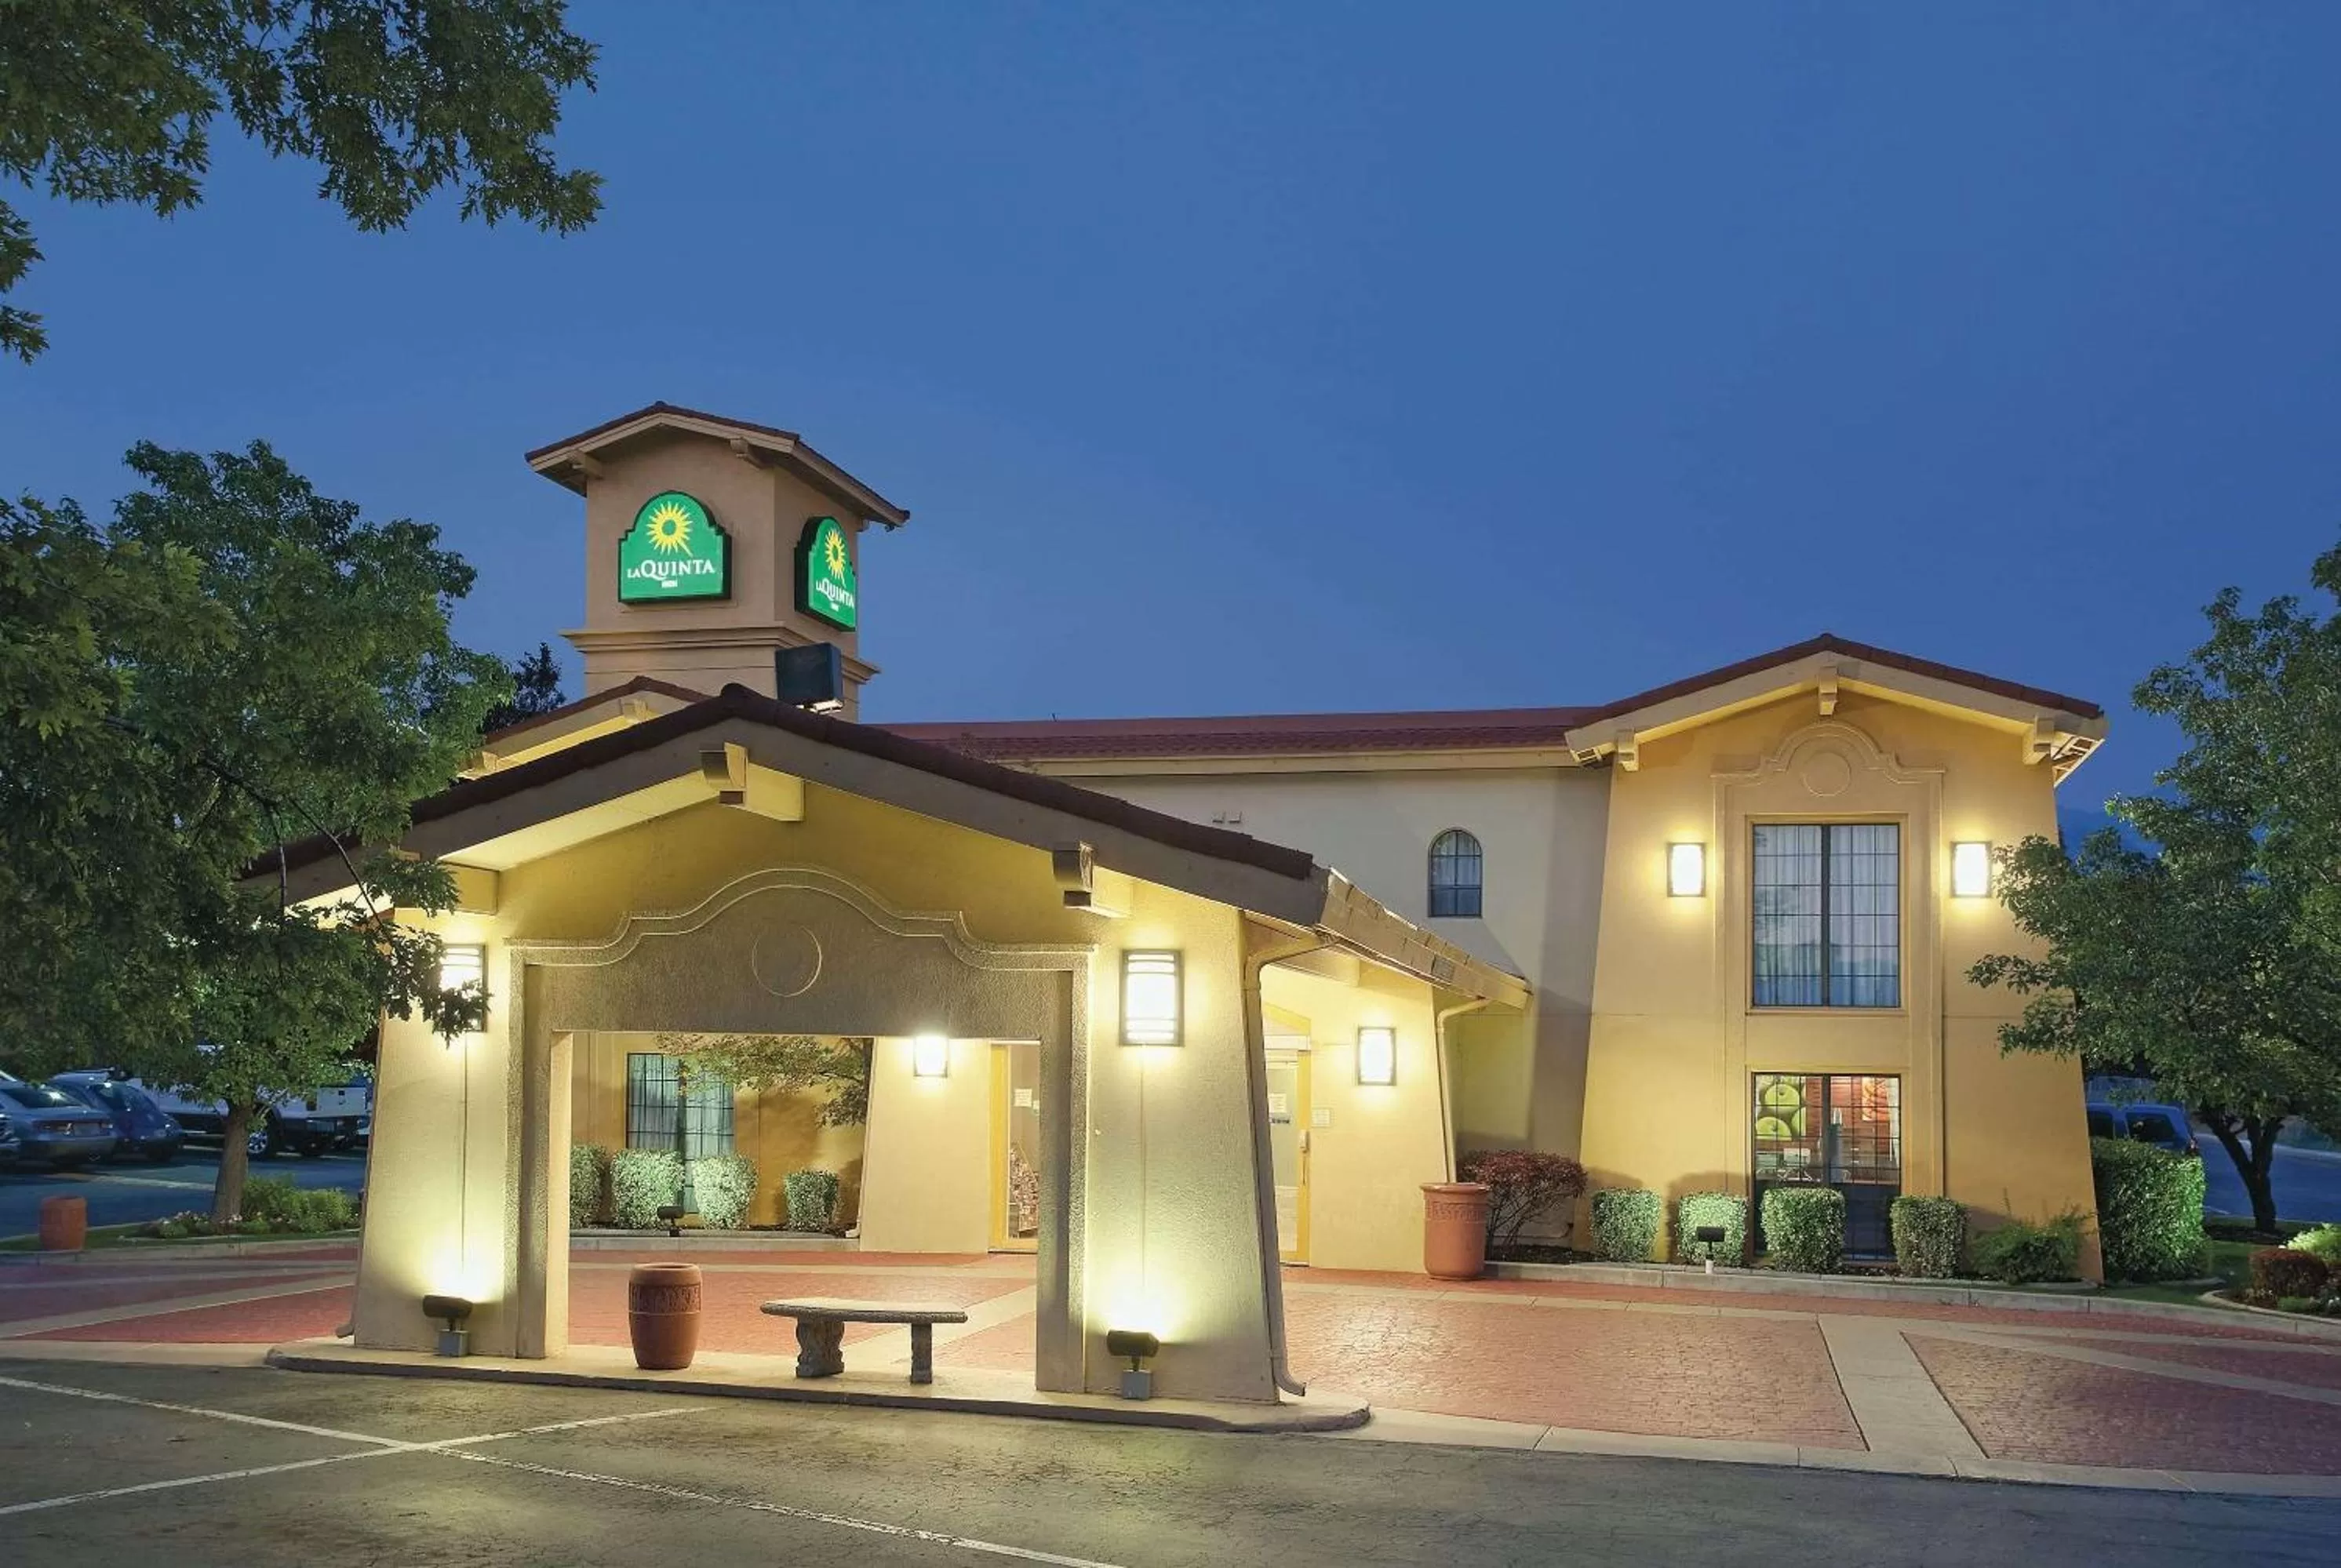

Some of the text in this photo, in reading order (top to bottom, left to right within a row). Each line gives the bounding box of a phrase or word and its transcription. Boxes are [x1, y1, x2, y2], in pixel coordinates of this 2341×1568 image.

[627, 559, 715, 580] LA QUINTA
[822, 578, 854, 609] QUINTA
